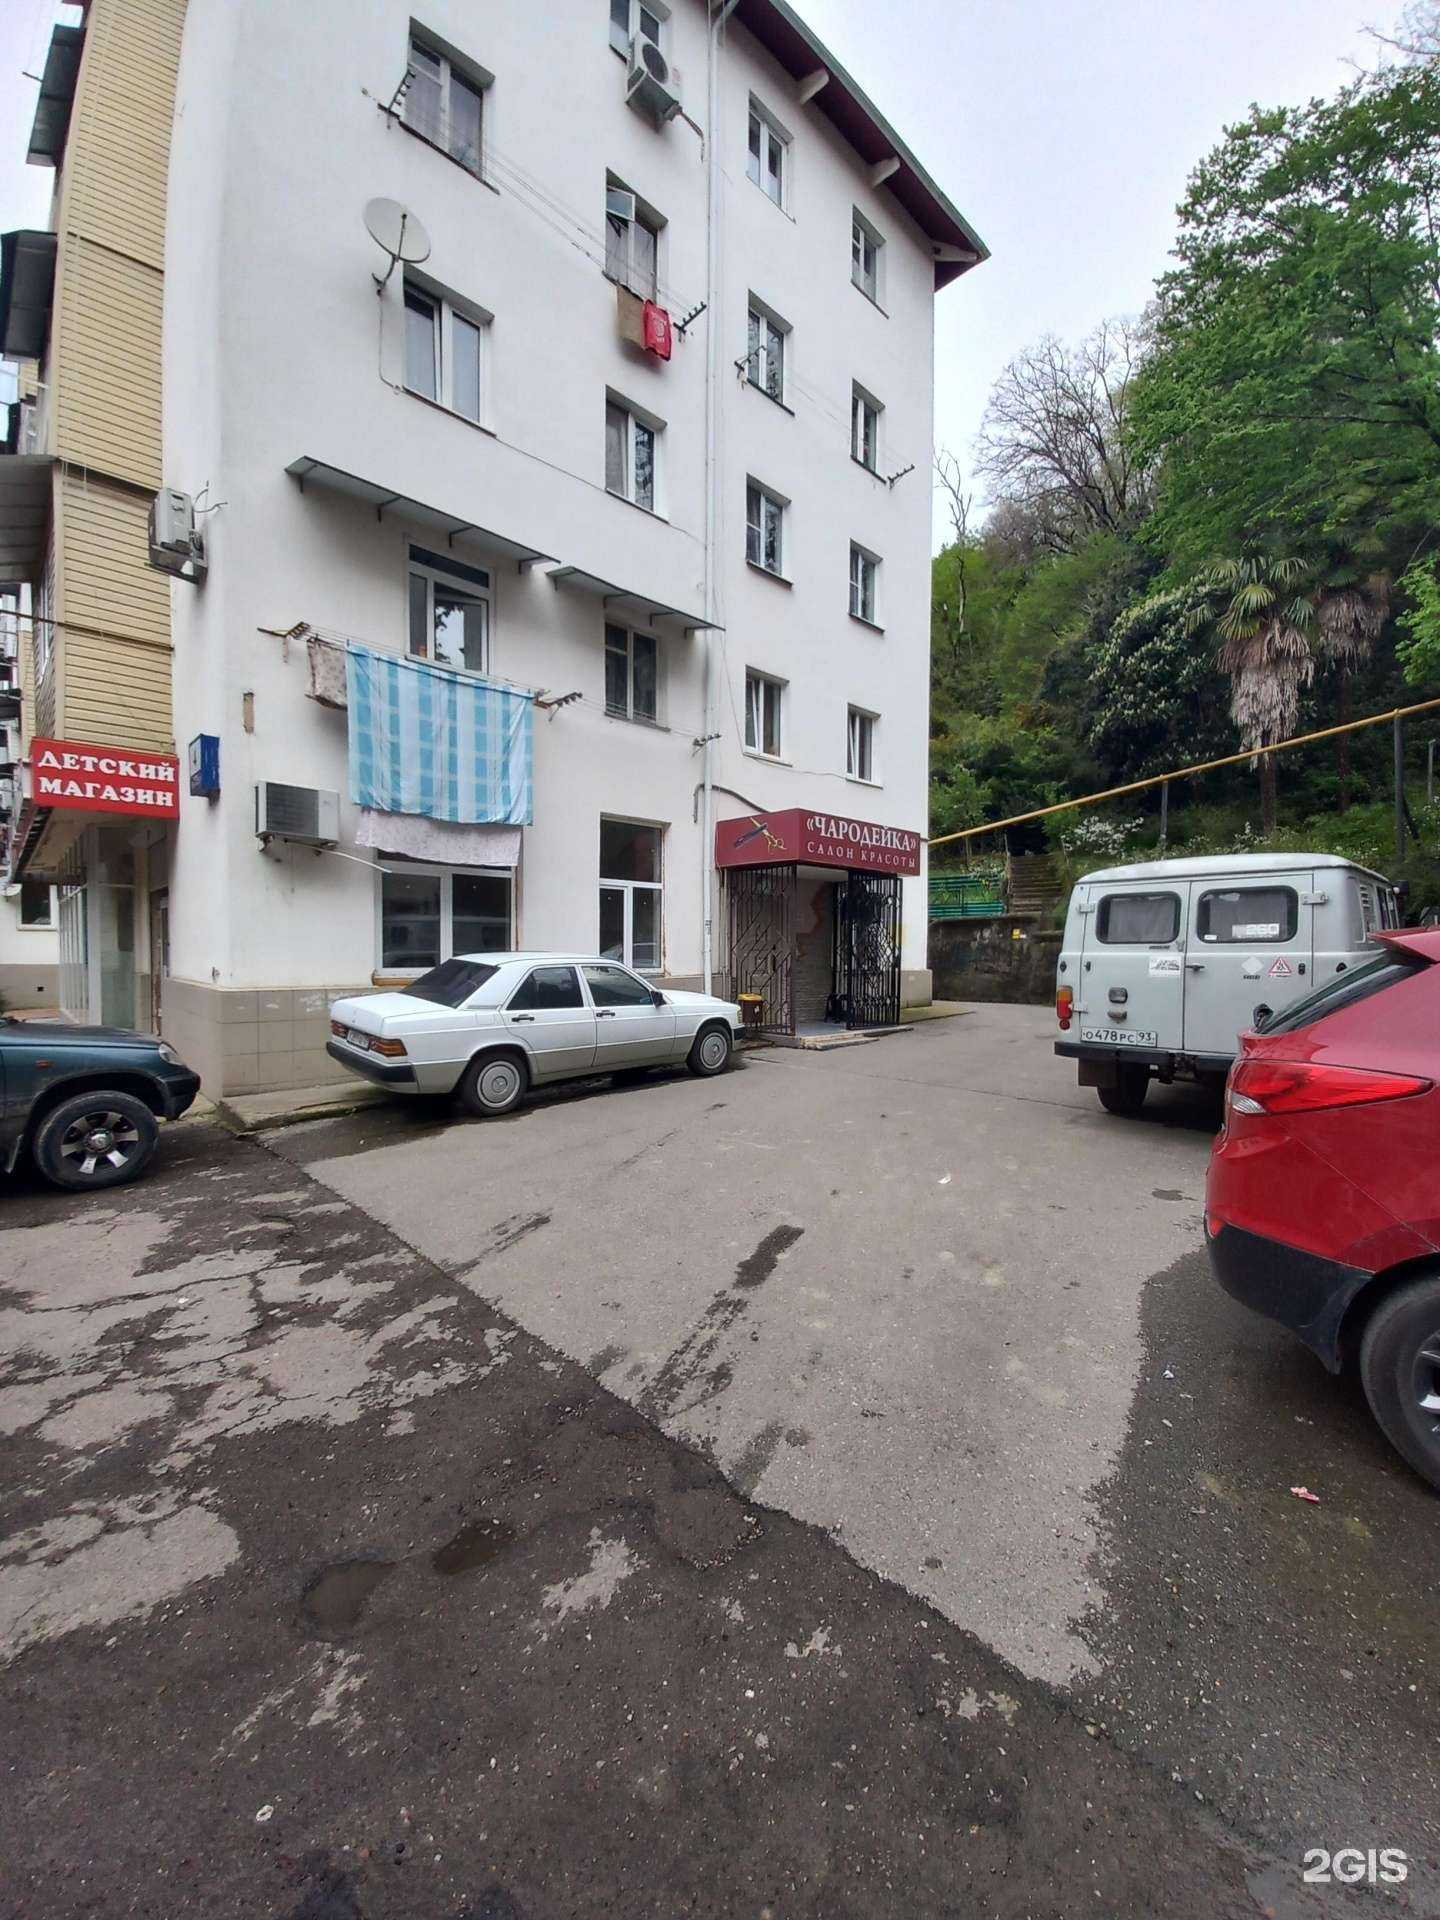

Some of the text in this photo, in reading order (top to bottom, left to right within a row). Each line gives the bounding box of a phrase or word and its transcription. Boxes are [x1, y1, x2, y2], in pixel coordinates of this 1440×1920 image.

[38, 751, 175, 782] ДЕТСКИЙ
[39, 777, 174, 807] МАГАЗИН
[806, 815, 917, 852] «ЧАРОДЕЙКА»
[807, 841, 916, 868] САЛОН КРАСОТЫ
